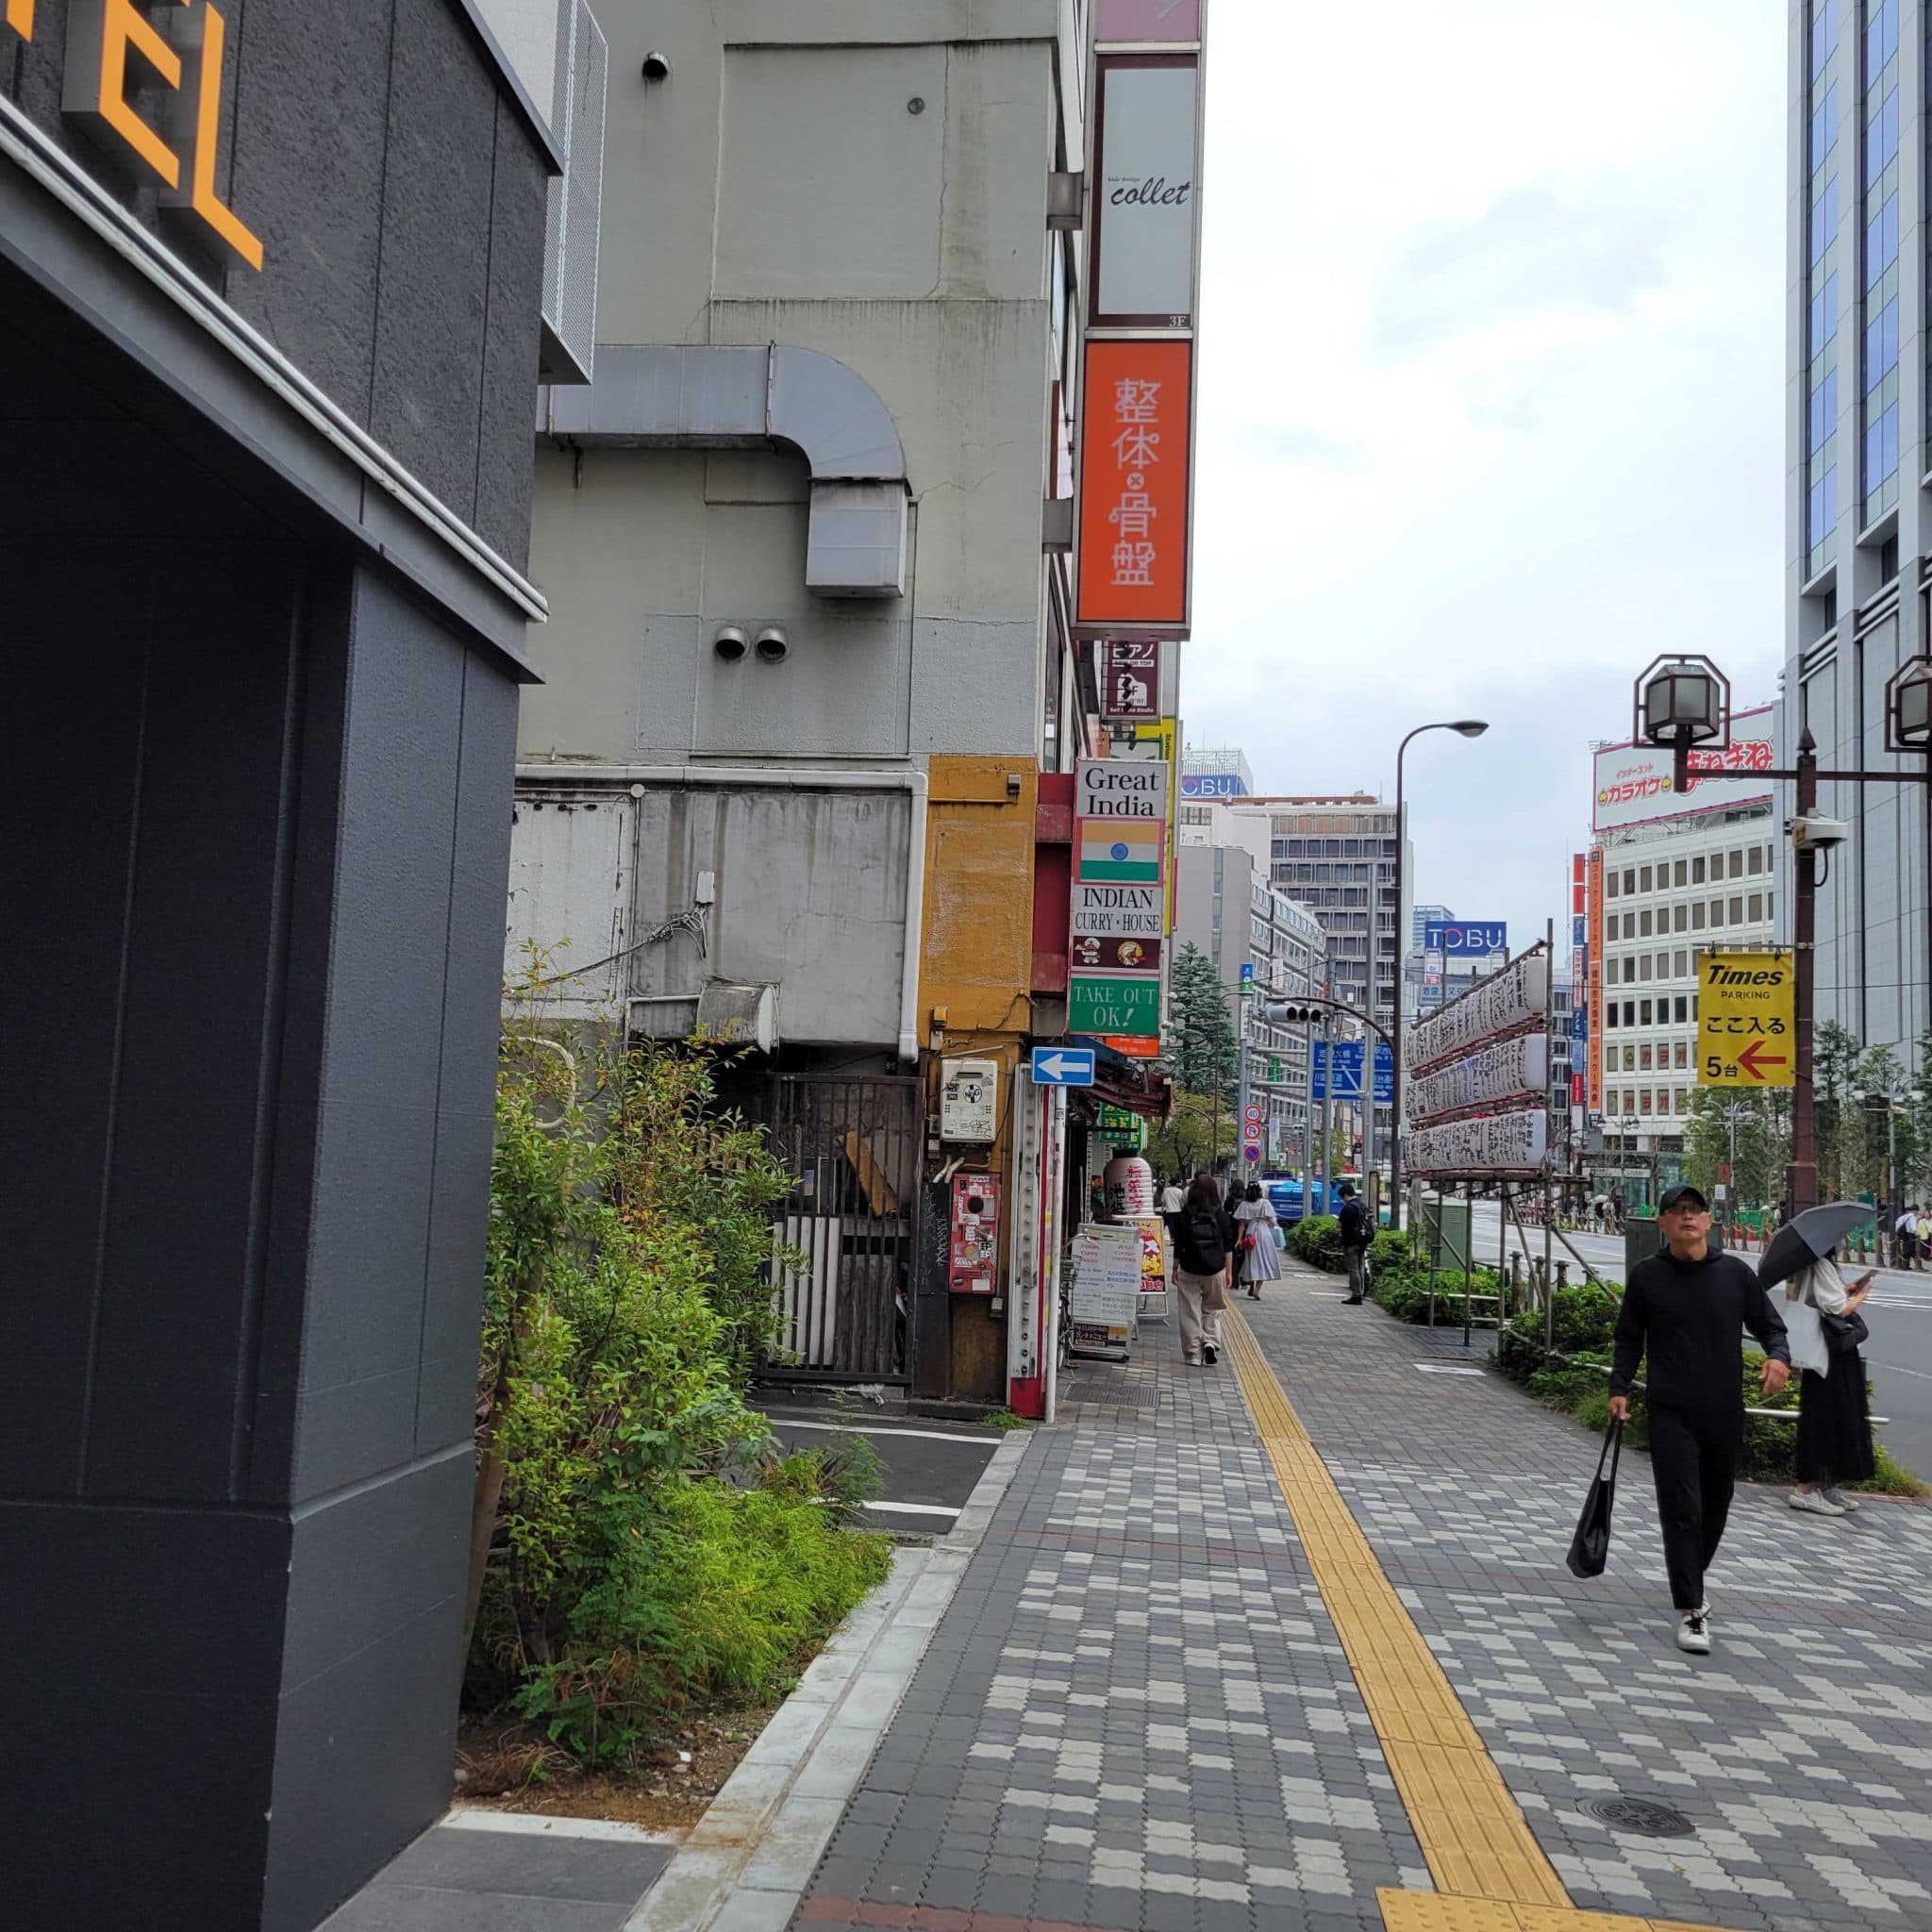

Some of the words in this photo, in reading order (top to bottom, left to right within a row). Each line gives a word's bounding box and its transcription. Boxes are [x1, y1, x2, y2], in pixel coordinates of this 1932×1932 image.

[1110, 176, 1191, 206] collet
[1169, 315, 1186, 327] 3F
[1085, 767, 1161, 791] Great
[1607, 776, 1661, 805] カラオケ
[1087, 794, 1156, 817] India
[1082, 888, 1154, 909] INDIAN
[1074, 912, 1114, 931] CURRY
[1122, 913, 1159, 932] HOUSE
[1427, 927, 1502, 948] TOBU
[1707, 964, 1784, 986] Times
[1074, 986, 1115, 1005] TAKE
[1124, 988, 1156, 1005] OUT
[1721, 991, 1770, 1000] PARKING
[1093, 1006, 1134, 1027] OK!
[1707, 1017, 1786, 1035] ここ入る
[1706, 1056, 1738, 1077] 5台
